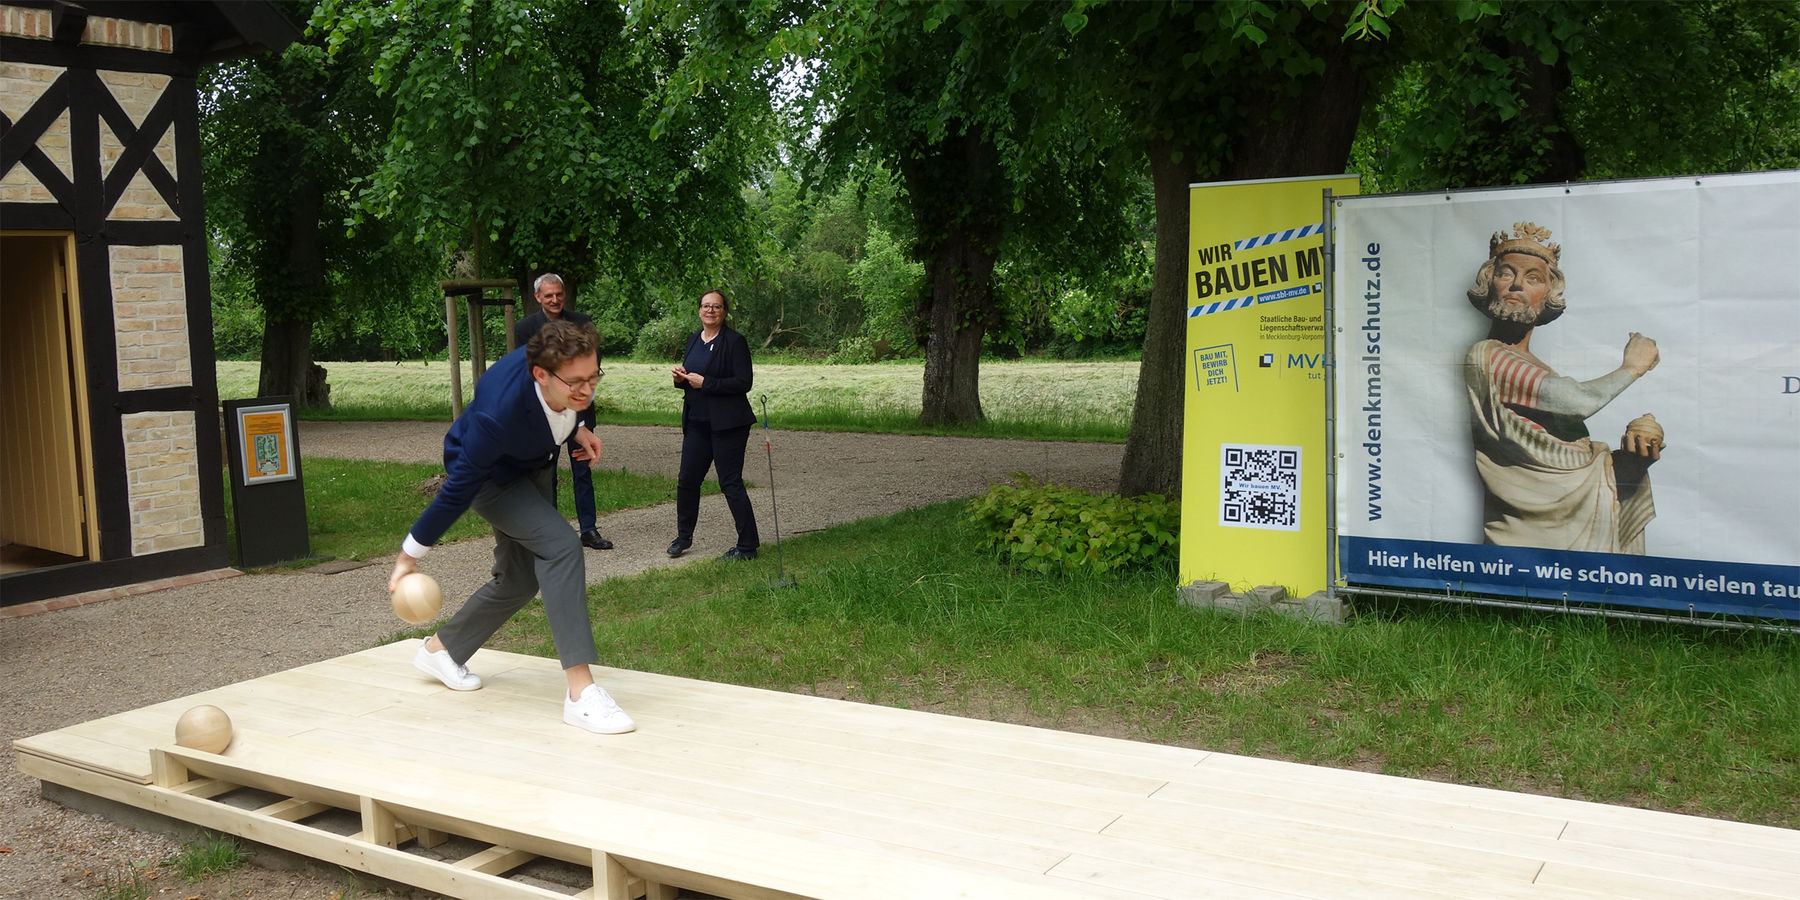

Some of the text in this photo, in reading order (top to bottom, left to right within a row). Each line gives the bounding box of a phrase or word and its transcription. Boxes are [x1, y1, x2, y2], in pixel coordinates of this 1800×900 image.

[1198, 243, 1232, 266] WIR
[1195, 254, 1289, 299] BAUEN
[1258, 287, 1307, 302] www.sbl-mv.de
[1260, 315, 1322, 323] Staatliche Bau- und
[1200, 353, 1213, 362] BAU
[1202, 359, 1228, 370] BEWIRB
[1288, 354, 1320, 369] MV
[1208, 368, 1224, 377] DICH
[1206, 376, 1228, 386] JETZT!
[1362, 242, 1382, 522] www.denkmalschutz.de
[1368, 550, 1409, 568] Hier
[1413, 552, 1475, 573] helfen
[1480, 559, 1513, 576] wir
[1535, 562, 1573, 580] wie
[1577, 566, 1643, 586] schon
[1649, 574, 1678, 589] an
[1683, 574, 1756, 596] vielen
[1762, 580, 1800, 599] tau
